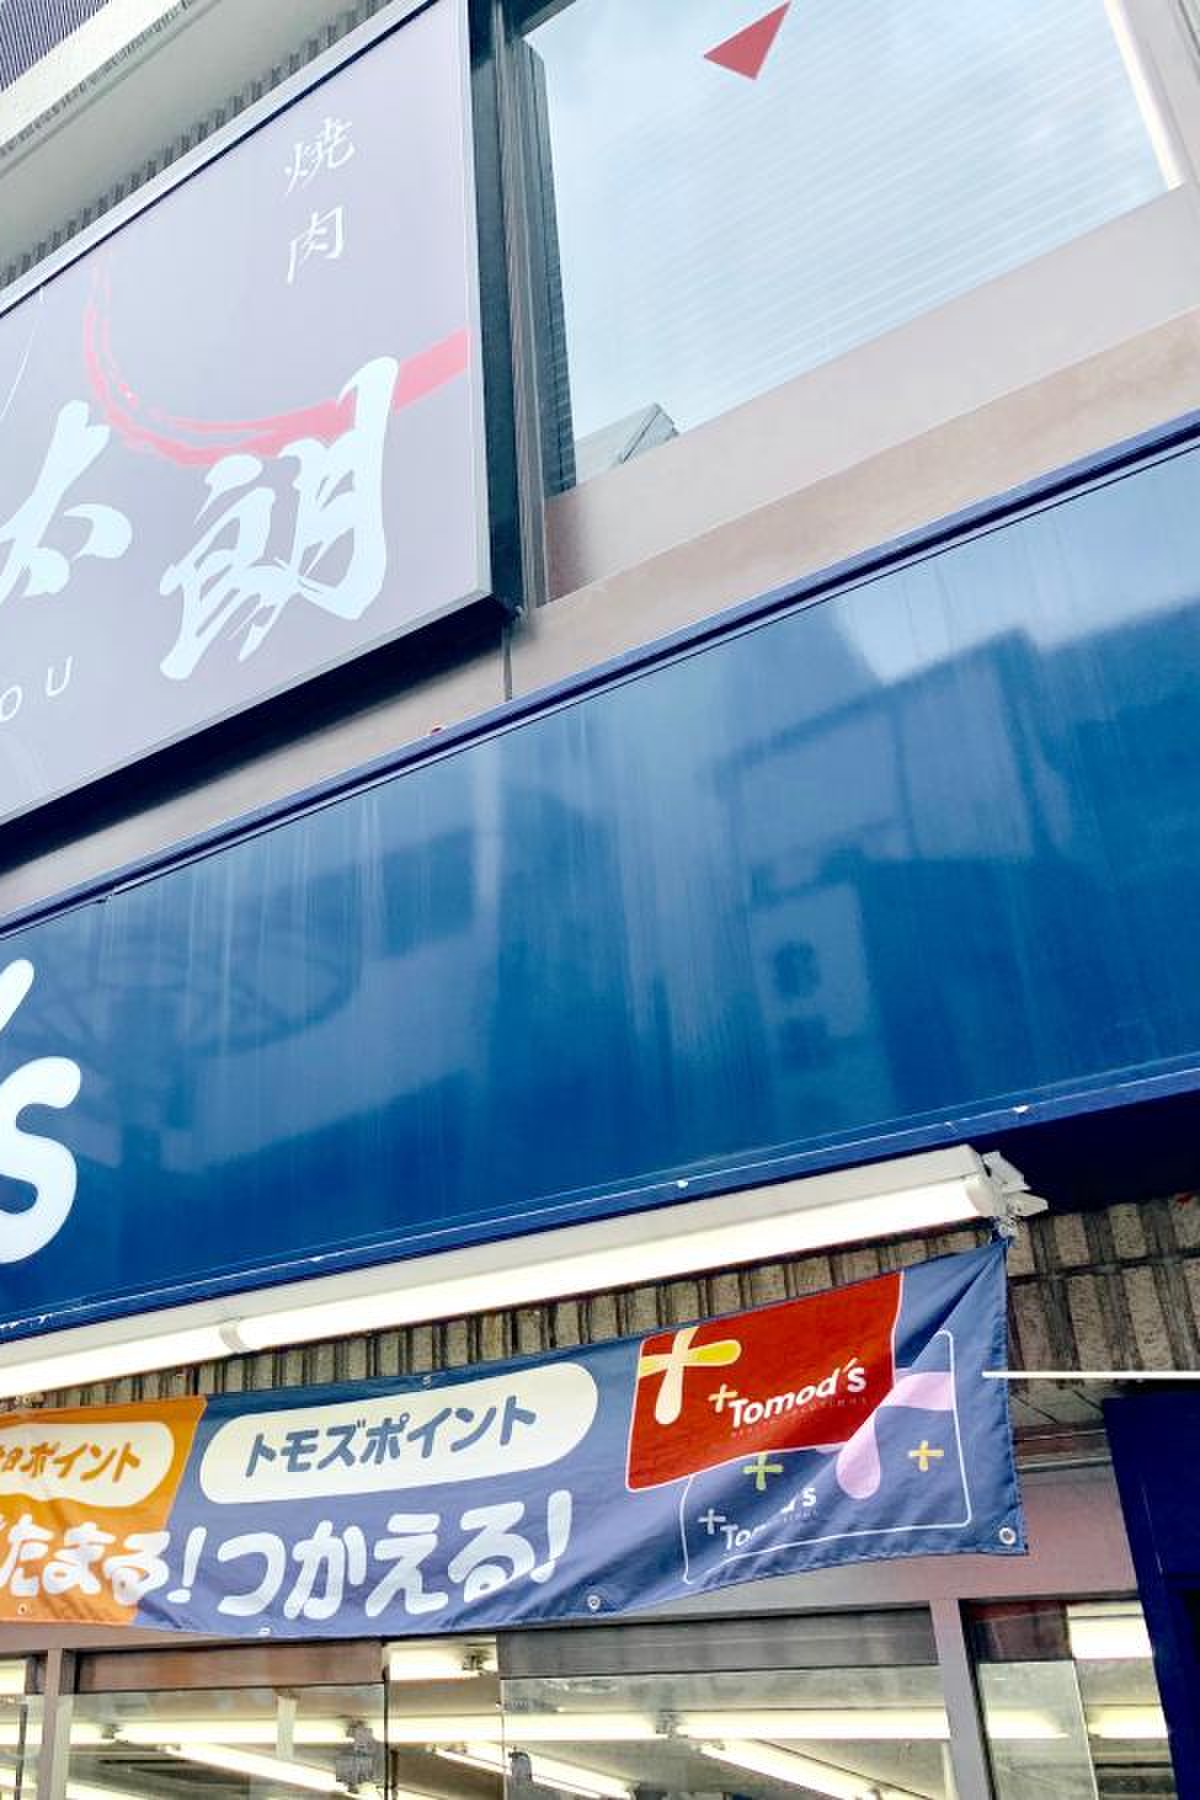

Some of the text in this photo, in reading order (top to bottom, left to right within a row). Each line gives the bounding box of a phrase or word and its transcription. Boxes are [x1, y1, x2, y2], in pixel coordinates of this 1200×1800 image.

[284, 116, 354, 284] 焼肉
[729, 1357, 868, 1428] Tomod's
[245, 1395, 538, 1478] トモズポイント
